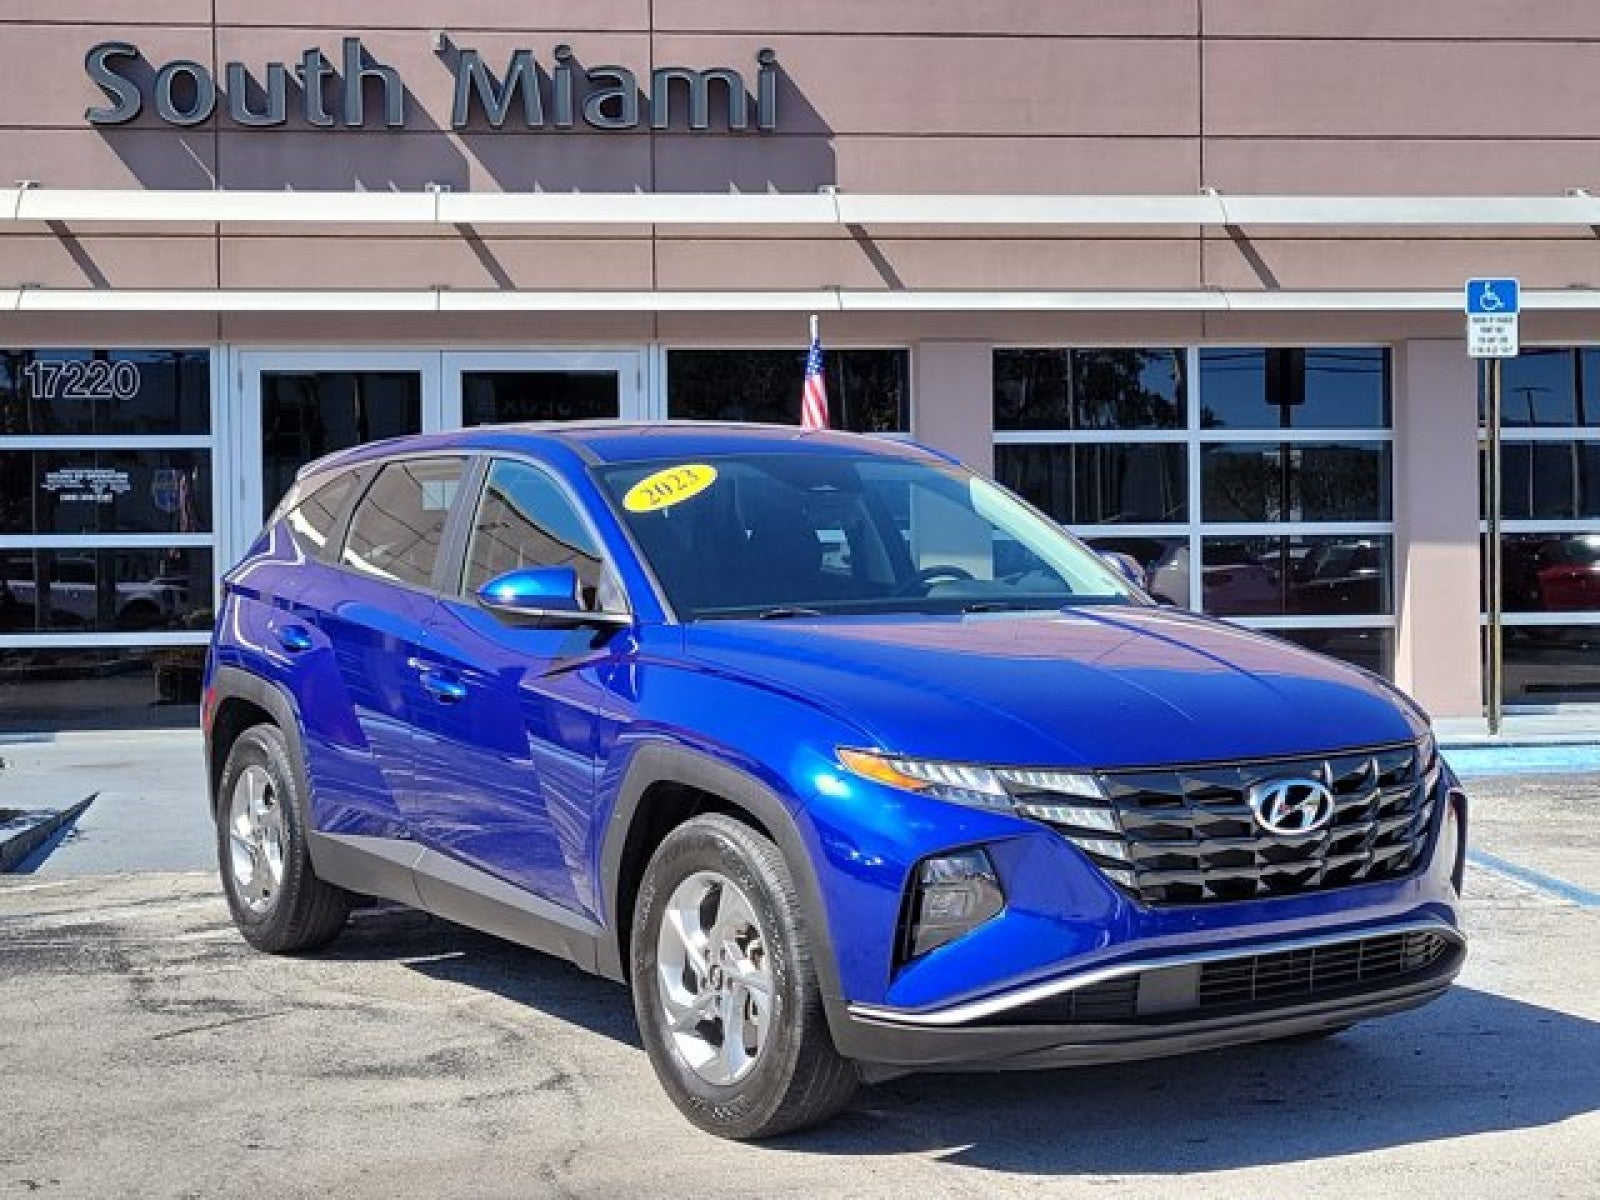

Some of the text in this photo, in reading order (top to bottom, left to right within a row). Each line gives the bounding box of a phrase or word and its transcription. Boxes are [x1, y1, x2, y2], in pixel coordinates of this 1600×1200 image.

[84, 37, 777, 132] South Miami
[25, 359, 140, 400] 17220
[639, 469, 700, 506] 2023
